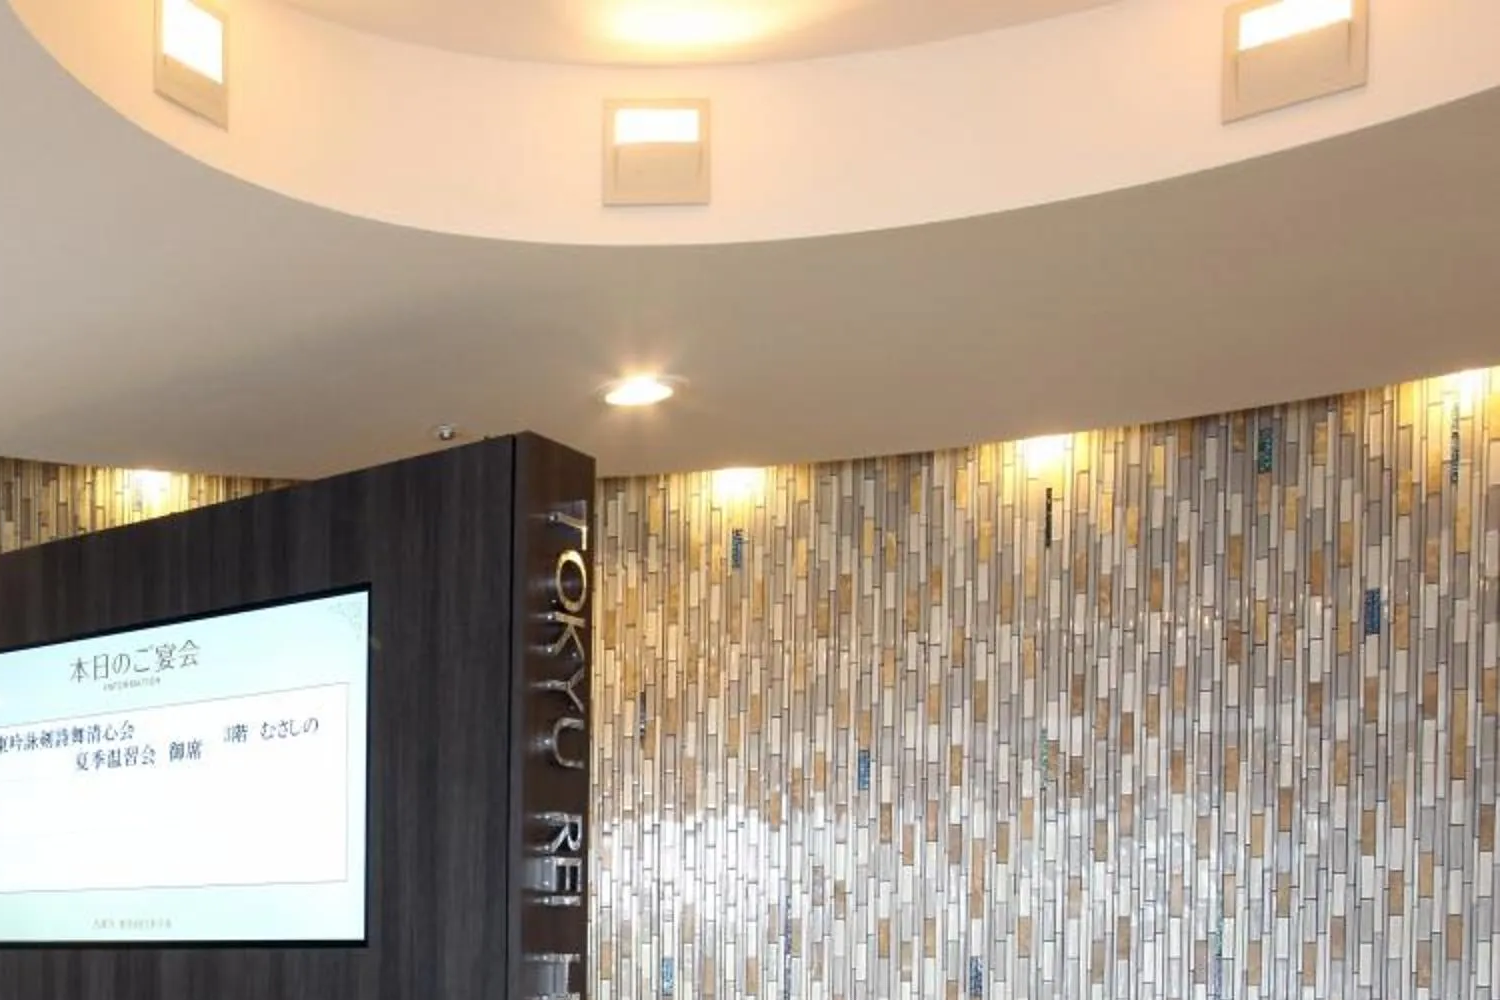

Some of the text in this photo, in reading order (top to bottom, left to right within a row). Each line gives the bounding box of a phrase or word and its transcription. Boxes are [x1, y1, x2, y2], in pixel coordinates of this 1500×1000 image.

[69, 639, 201, 683] 本日のご宴会
[549, 500, 588, 769] TOKYU
[260, 716, 320, 741] むさしの
[544, 812, 583, 906] REI
